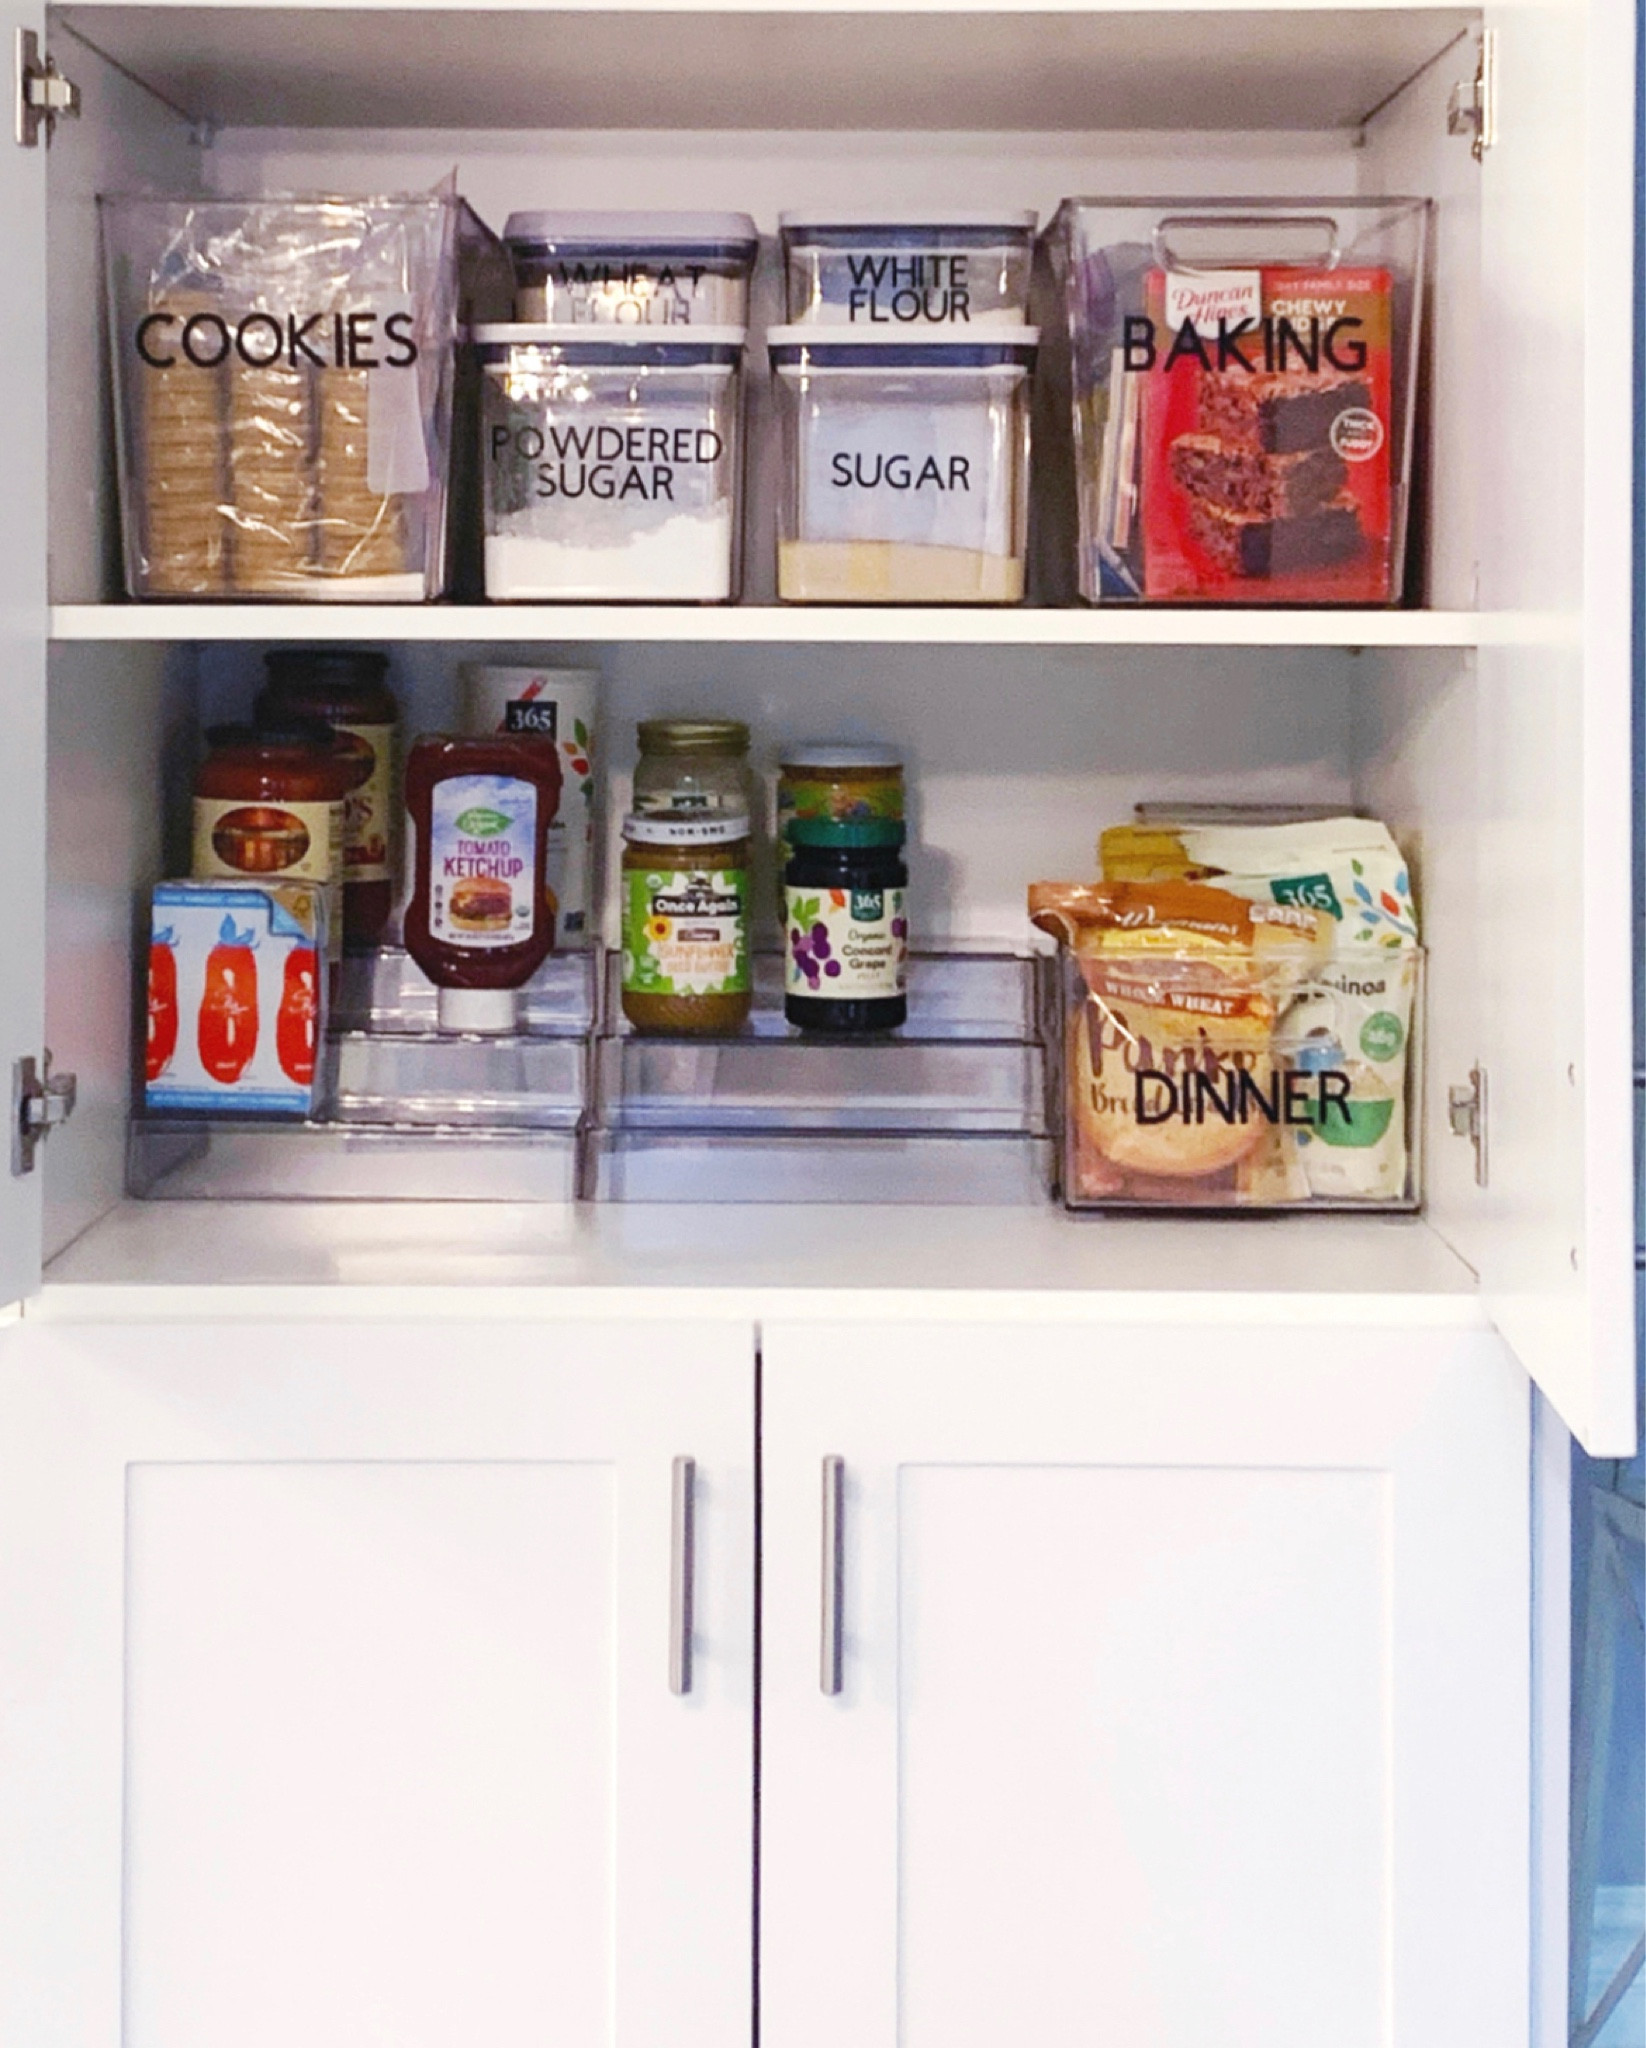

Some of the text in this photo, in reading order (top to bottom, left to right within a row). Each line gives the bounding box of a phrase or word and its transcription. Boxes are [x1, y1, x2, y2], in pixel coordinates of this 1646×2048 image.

[558, 262, 706, 298] WHEAT
[847, 255, 969, 289] WHITE
[848, 289, 970, 323] FLOUR
[1172, 285, 1254, 310] Duncan
[1269, 299, 1347, 316] CHEWY
[1193, 302, 1251, 324] Hines
[136, 312, 419, 368] COOKIES
[1122, 316, 1368, 372] BAKING
[492, 425, 723, 464] POWDERED
[536, 463, 675, 501] SUGAR
[832, 453, 970, 491] SUGAR
[510, 706, 552, 731] 365
[457, 840, 512, 855] TOMATO
[443, 857, 524, 878] KETCHUP
[655, 898, 738, 916] Once Again
[855, 894, 881, 909] 365
[1283, 884, 1334, 910] 365
[848, 957, 886, 970] Grape
[1335, 974, 1387, 996] inoa
[1170, 993, 1235, 1014] WHEAT
[1087, 1000, 1257, 1083] Panko
[1135, 1070, 1352, 1125] DINNER
